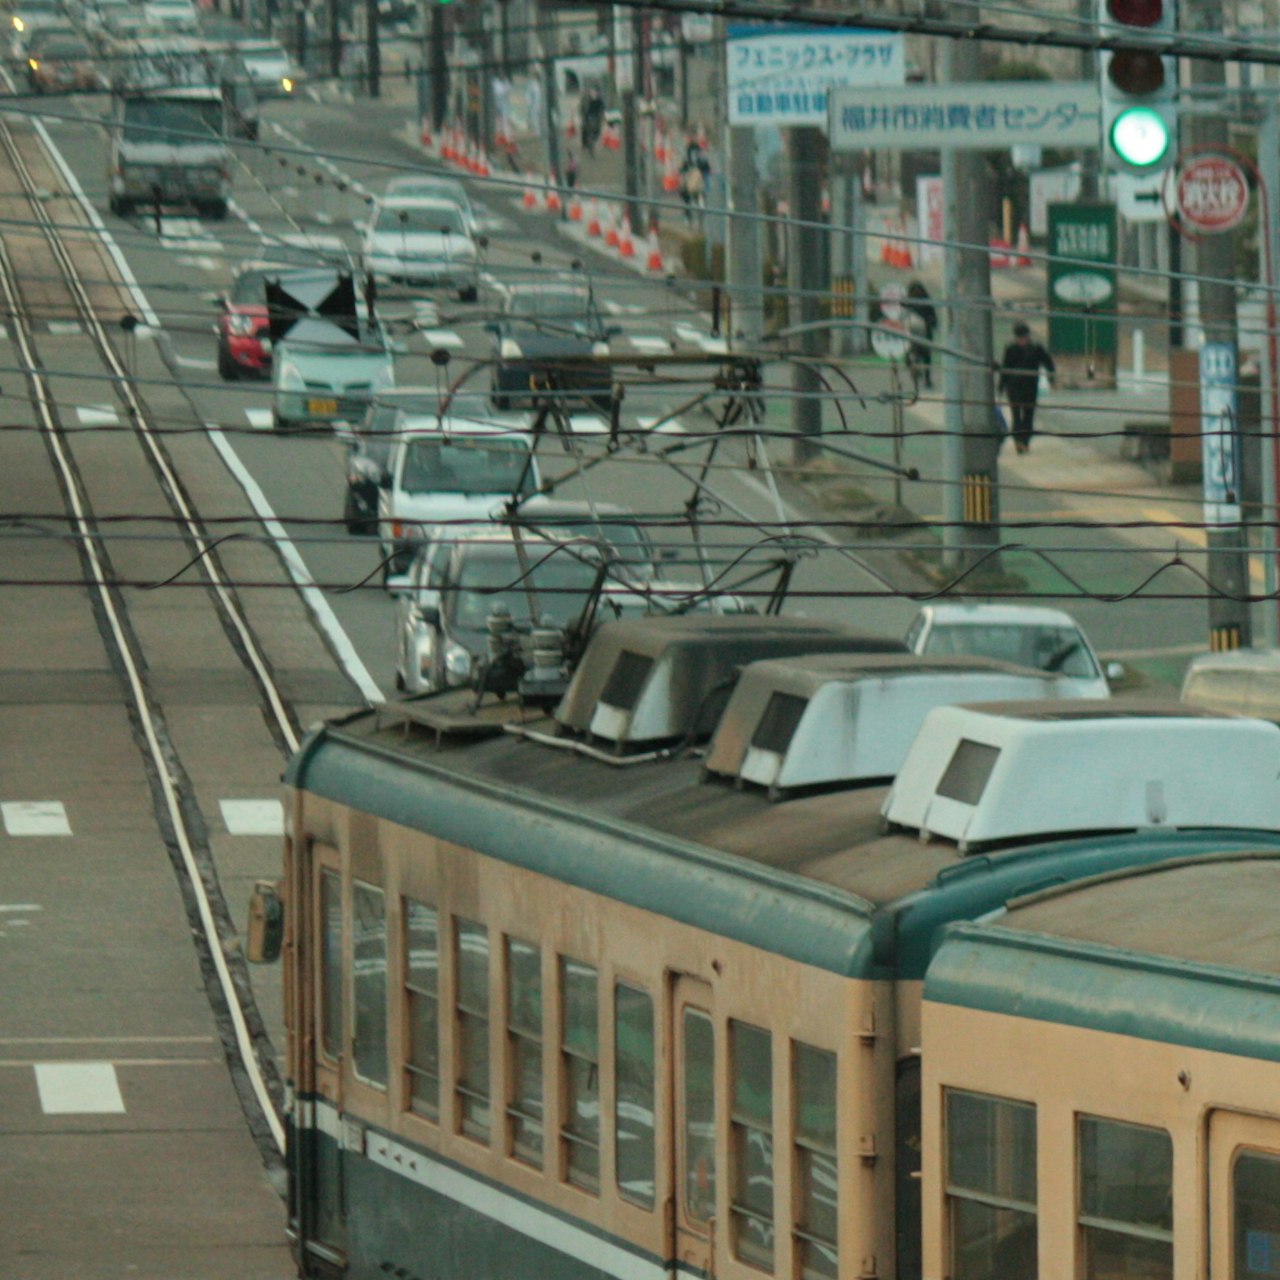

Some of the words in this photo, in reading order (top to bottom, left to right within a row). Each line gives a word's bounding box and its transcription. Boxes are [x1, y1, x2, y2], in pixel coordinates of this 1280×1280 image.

[841, 103, 1098, 132] 福井市消費者センター
